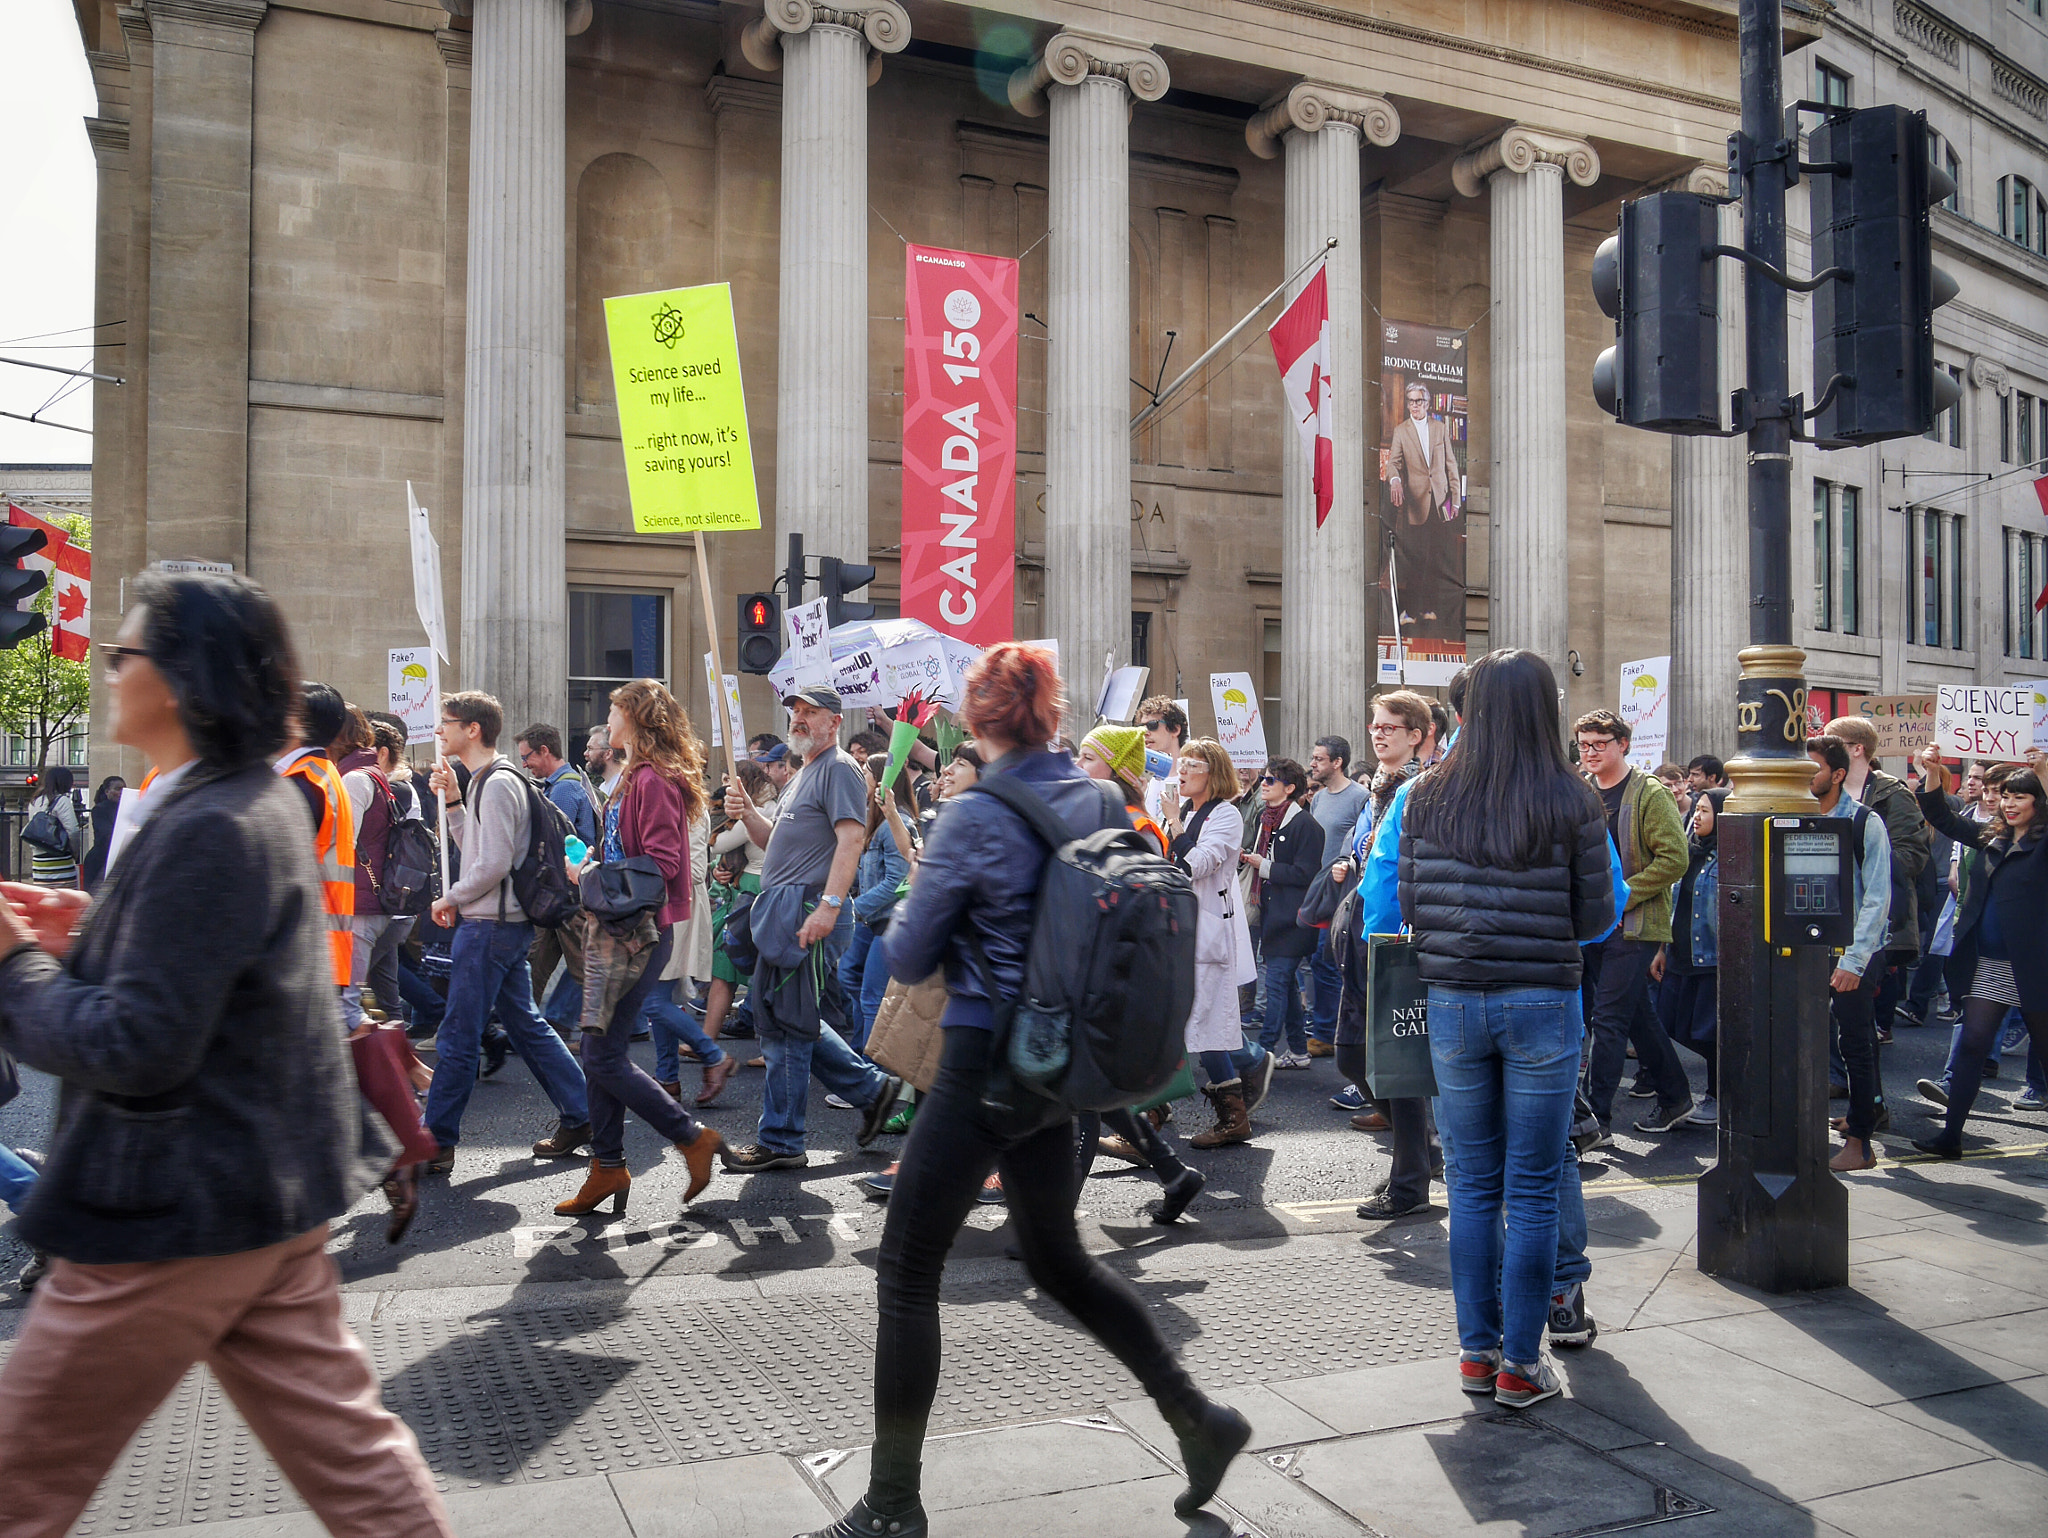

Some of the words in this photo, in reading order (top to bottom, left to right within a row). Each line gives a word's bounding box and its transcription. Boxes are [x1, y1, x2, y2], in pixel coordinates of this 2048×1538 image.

[916, 255, 965, 268] #CANADA150
[629, 366, 678, 383] Science
[682, 358, 722, 378] saved
[1384, 356, 1421, 370] RODNEY
[1424, 361, 1463, 376] GRAHAM
[650, 391, 669, 408] my
[647, 431, 677, 452] right
[681, 432, 713, 447] now,
[717, 426, 738, 443] it's
[645, 455, 686, 474] saving
[689, 451, 731, 473] yours!
[644, 515, 683, 528] Science,
[686, 514, 702, 525] not
[939, 402, 979, 625] CANADA
[391, 652, 415, 662] Fake?
[1622, 664, 1645, 676] Fake?
[1211, 678, 1231, 688] Fake?
[391, 692, 410, 702] Real.
[1940, 687, 2030, 716] SCIENCE
[1860, 700, 1933, 719] SCIENC
[1877, 722, 1893, 733] IKE
[1899, 721, 1934, 732] MAGIC
[1974, 717, 1989, 728] IS
[1877, 737, 1893, 748] UT
[1900, 735, 1930, 748] REAL
[1954, 728, 2019, 756] SEXY
